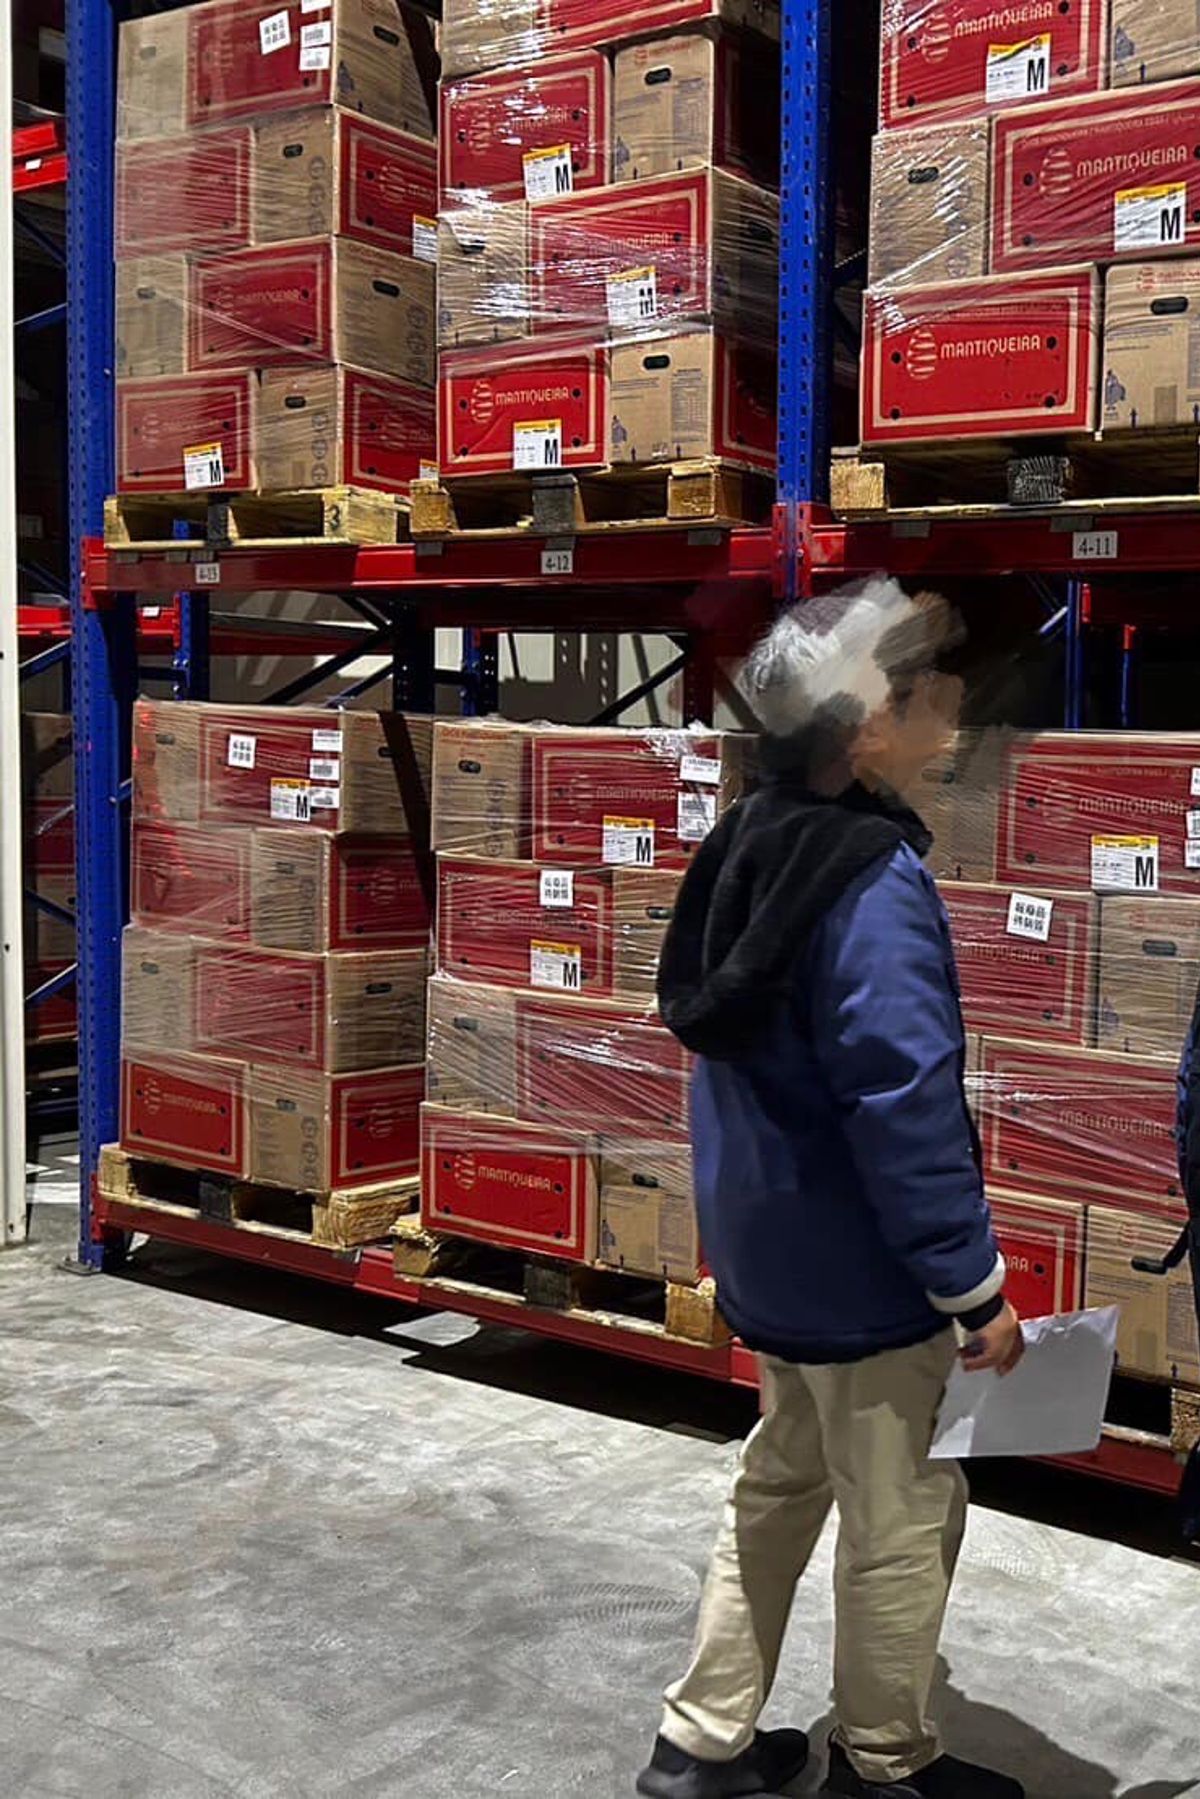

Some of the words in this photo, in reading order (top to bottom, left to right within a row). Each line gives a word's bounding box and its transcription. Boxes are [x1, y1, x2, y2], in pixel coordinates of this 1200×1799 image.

[954, 2, 1053, 37] MANTIQUEIRA
[1027, 58, 1045, 91] M
[1077, 145, 1187, 177] MANTIQUEIRA
[555, 164, 570, 193] M
[1161, 207, 1180, 241] M
[941, 335, 1040, 359] MANTIQUEIRA
[495, 386, 569, 406] MANTIQUEIRA
[545, 438, 558, 464] M
[209, 459, 222, 483] M
[1078, 536, 1112, 556] 4-11
[545, 554, 570, 571] 4-12
[296, 795, 308, 819] M
[636, 836, 651, 862] M
[1135, 856, 1154, 887] M
[563, 962, 577, 988] M
[478, 1166, 551, 1191] MANTIQUEIRA
